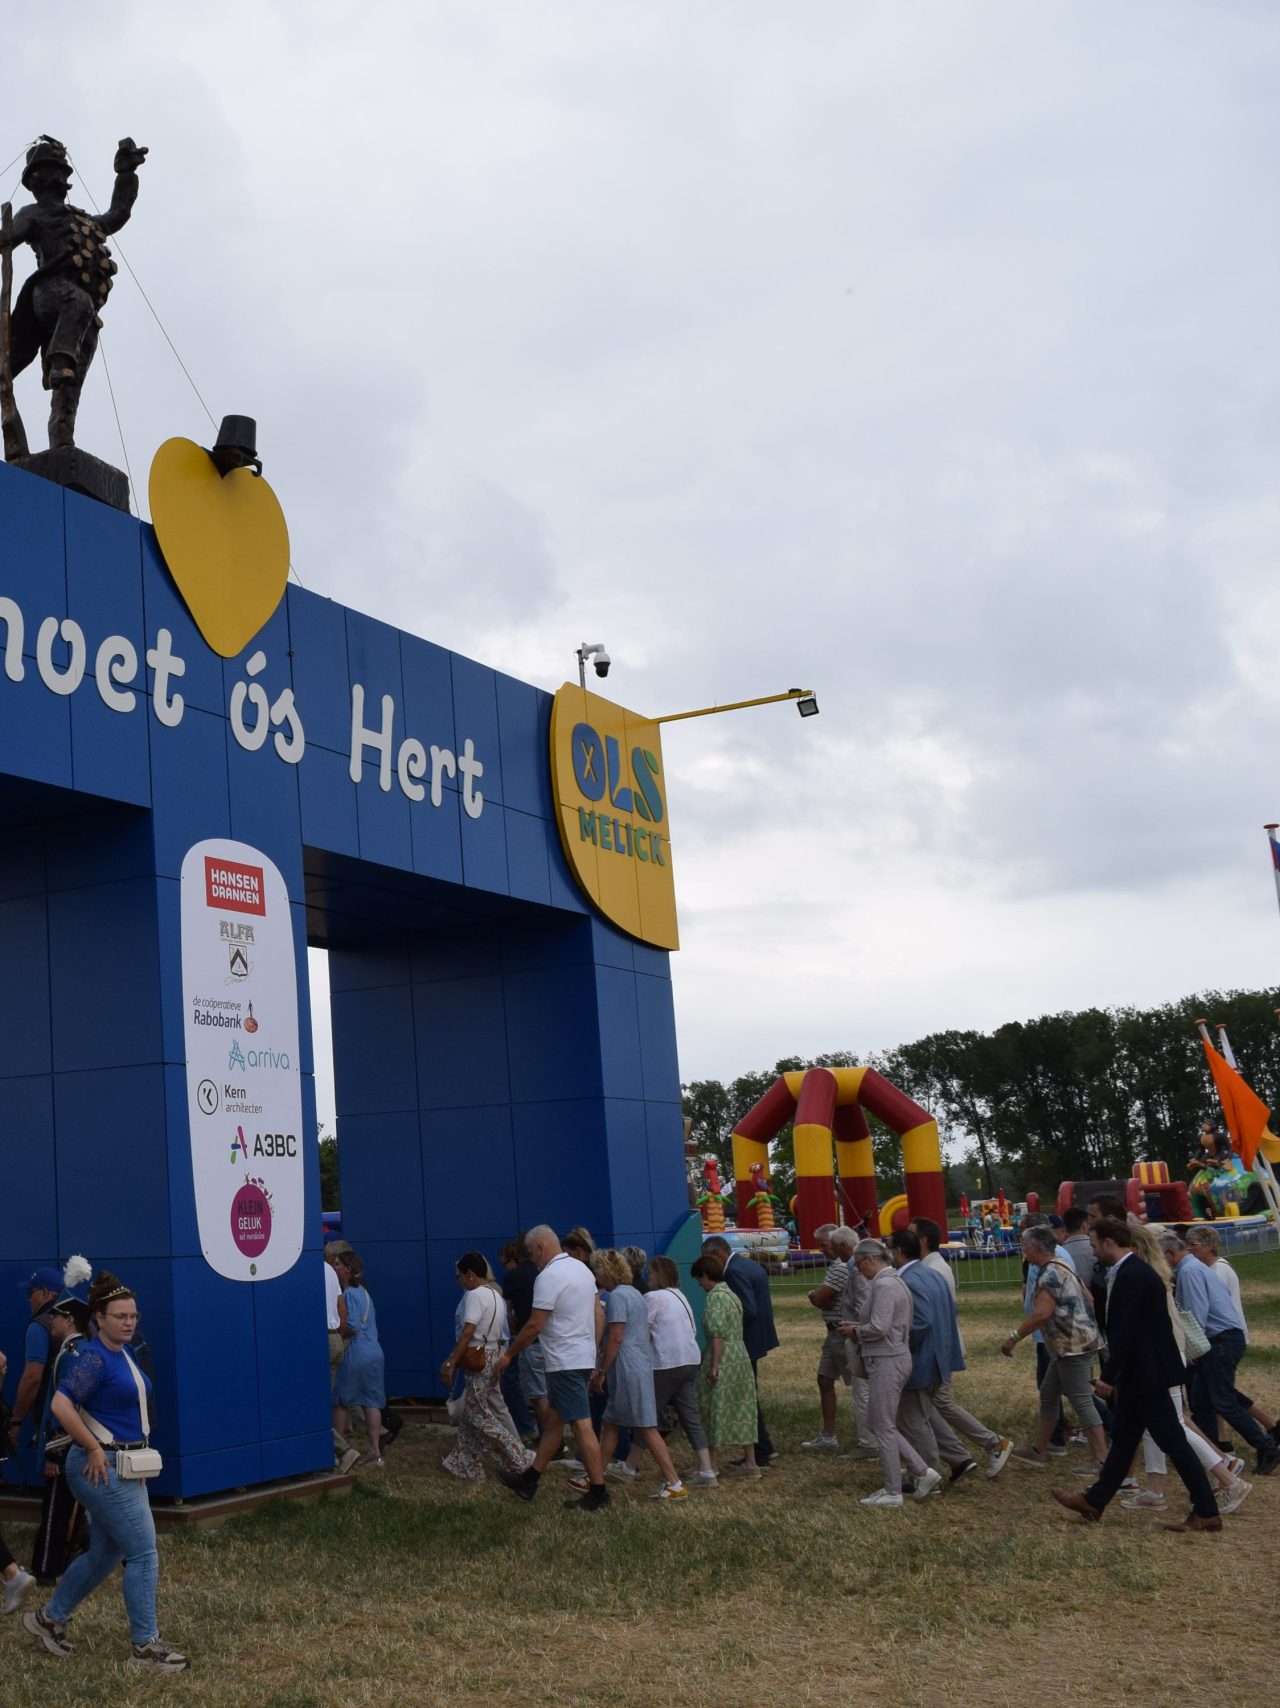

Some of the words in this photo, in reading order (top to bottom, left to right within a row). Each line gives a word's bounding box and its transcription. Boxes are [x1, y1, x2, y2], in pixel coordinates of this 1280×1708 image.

[229, 650, 305, 764] ós
[349, 683, 484, 818] Hert
[572, 722, 663, 823] OLS
[578, 806, 665, 866] MELICK
[211, 868, 259, 891] HANSEN
[212, 884, 260, 905] DRANKEN
[220, 920, 255, 942] ALFA
[192, 995, 201, 1007] de
[193, 1009, 242, 1029] Rabobank
[247, 1047, 290, 1070] arriva
[224, 1084, 246, 1099] Kern
[225, 1103, 263, 1114] architecten
[253, 1133, 297, 1158] A3BC
[238, 1200, 263, 1216] KLEIN
[238, 1217, 262, 1230] GELUK
